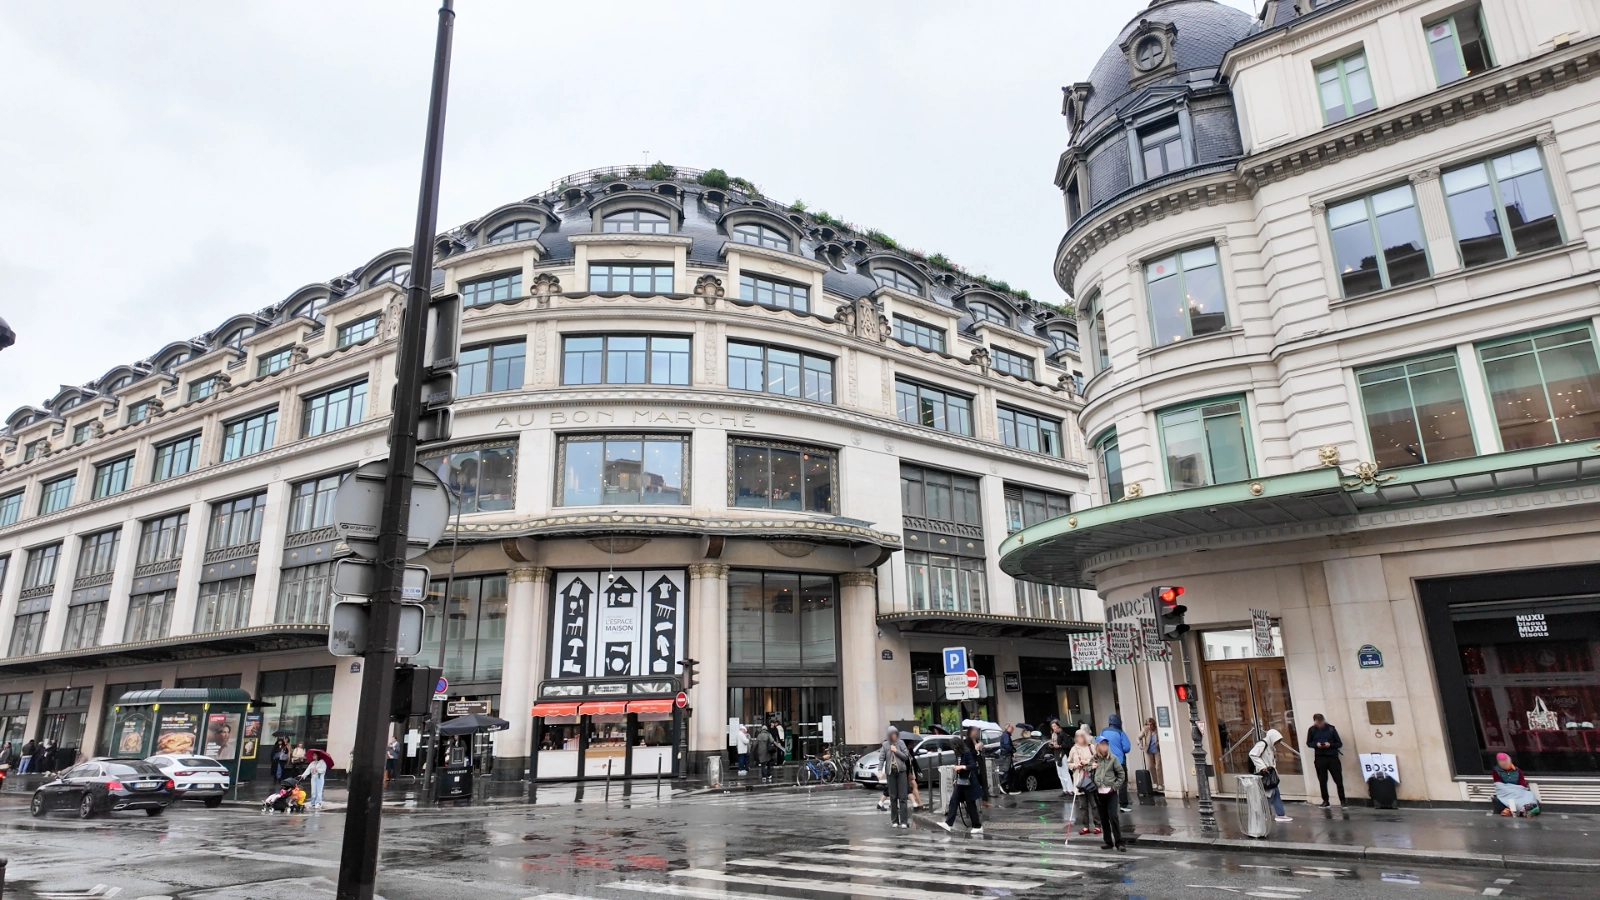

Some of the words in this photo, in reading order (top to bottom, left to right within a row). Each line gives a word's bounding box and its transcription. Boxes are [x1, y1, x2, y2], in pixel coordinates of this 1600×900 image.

[495, 413, 535, 429] AU
[549, 410, 615, 424] BON
[633, 409, 756, 428] MARCHÉ
[1112, 597, 1153, 619] MARCH
[949, 653, 960, 669] P
[1365, 764, 1394, 772] BOSS
